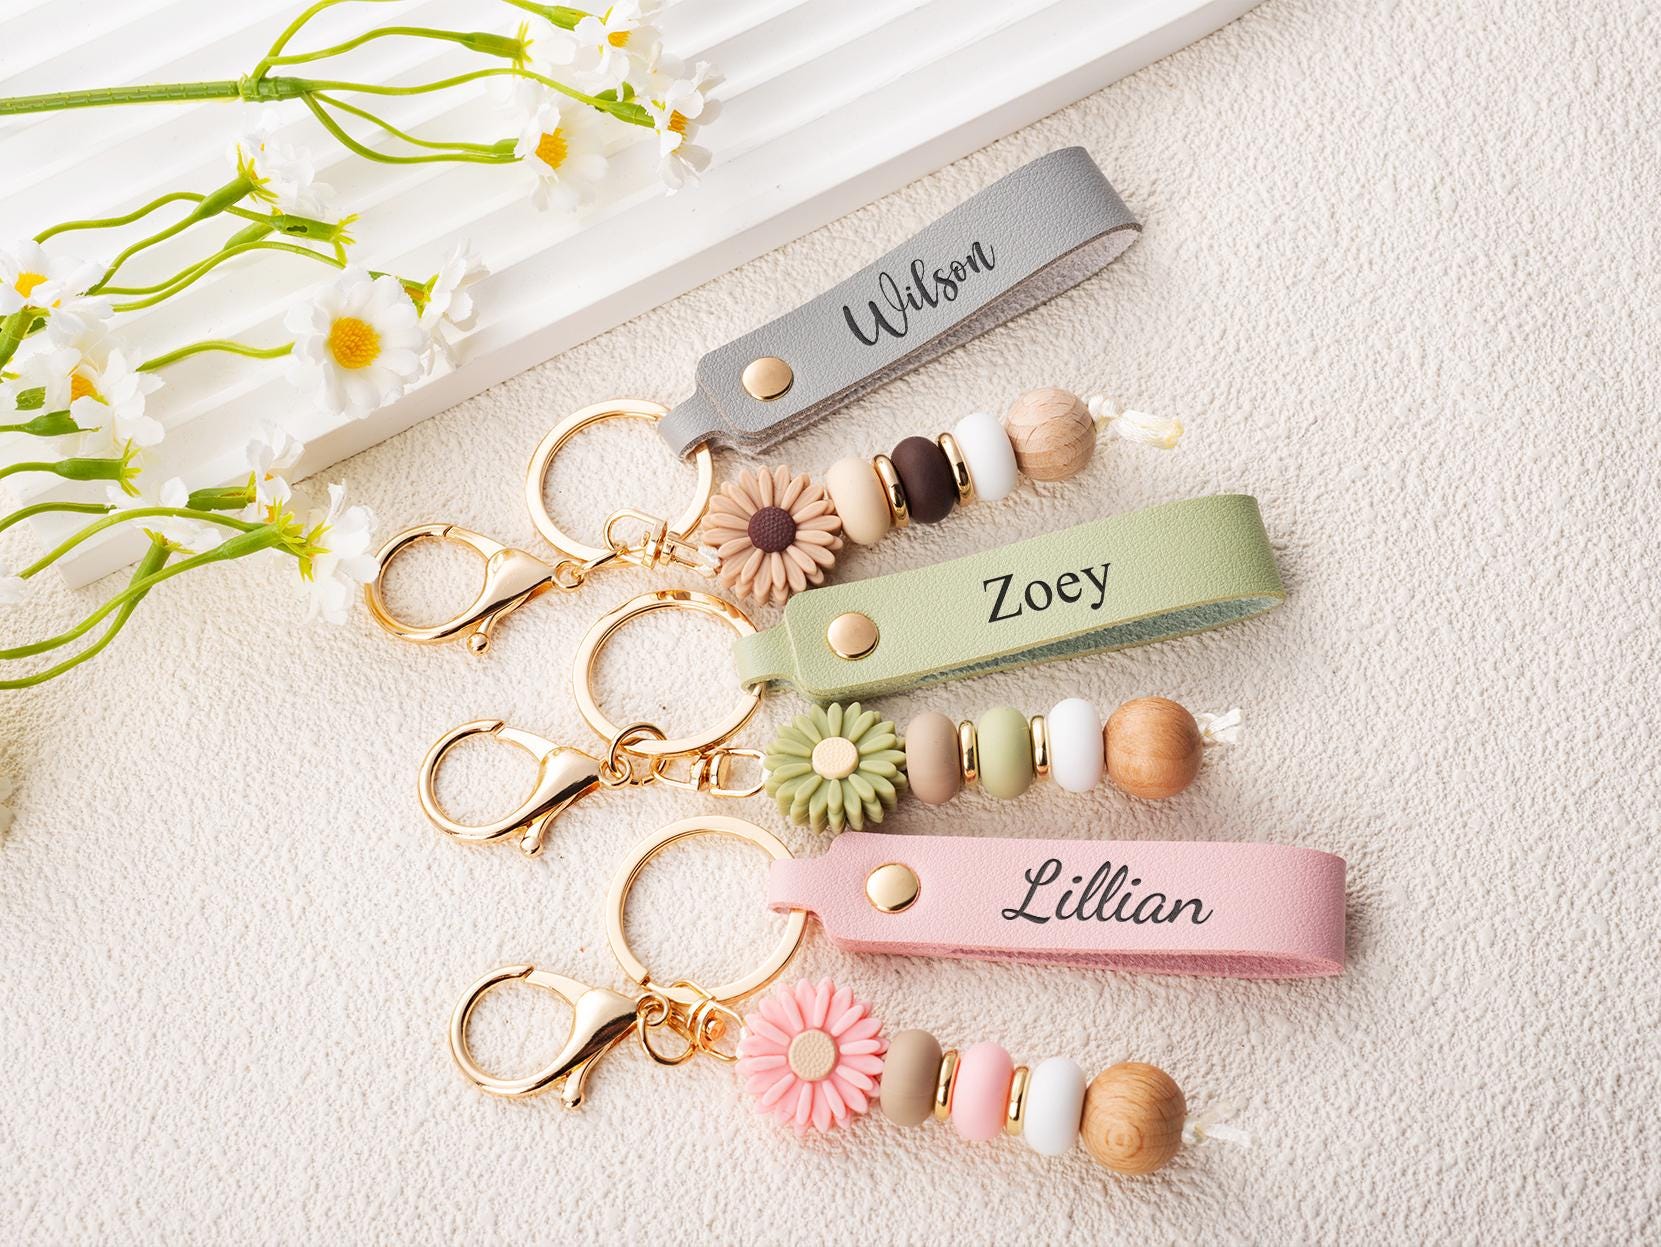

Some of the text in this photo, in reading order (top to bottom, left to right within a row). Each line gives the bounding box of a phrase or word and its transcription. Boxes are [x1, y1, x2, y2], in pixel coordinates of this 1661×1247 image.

[842, 241, 996, 346] Wilson
[983, 562, 1112, 623] Zoey
[1001, 858, 1214, 925] Lillian
